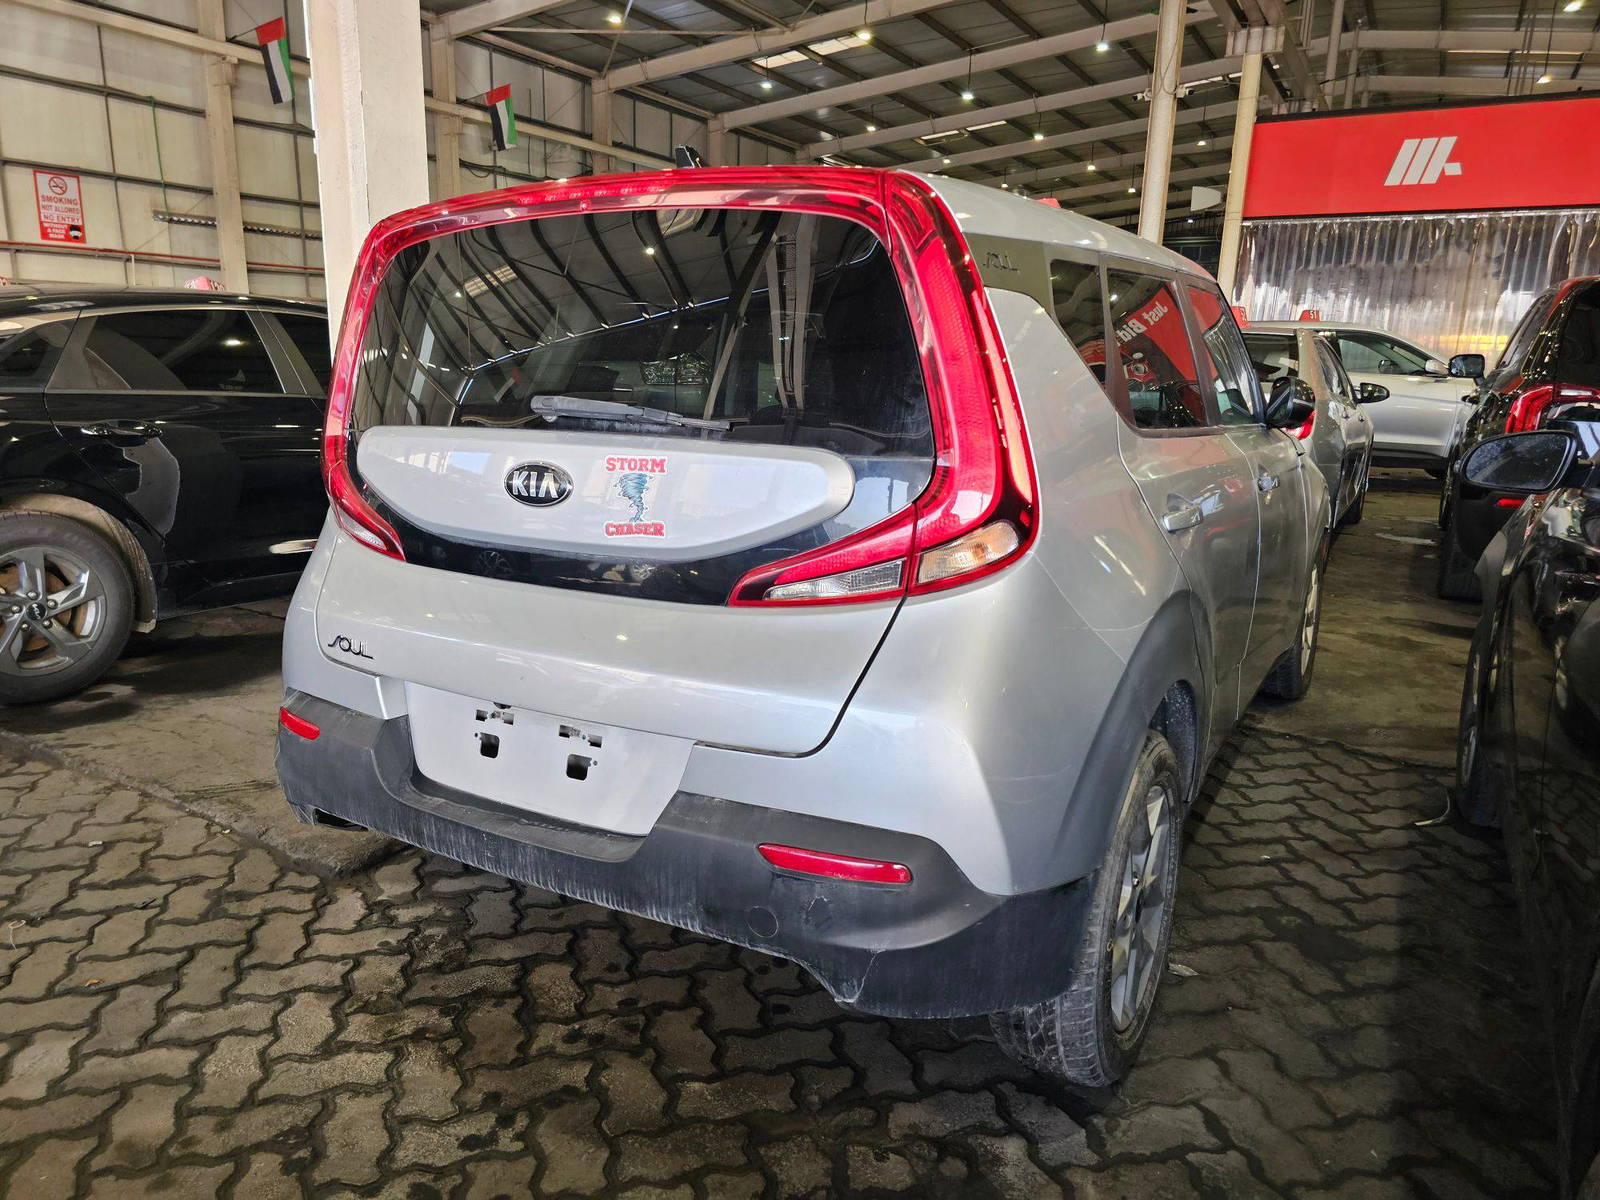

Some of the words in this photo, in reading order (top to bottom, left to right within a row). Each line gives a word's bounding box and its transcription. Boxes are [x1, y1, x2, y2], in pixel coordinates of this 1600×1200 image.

[41, 194, 78, 206] SMOKING
[41, 204, 53, 212] NOT
[54, 205, 80, 215] ALLOWED
[43, 214, 55, 222] NO
[56, 215, 80, 224] ENTRY
[1309, 310, 1317, 320] 51
[605, 457, 667, 473] STORM
[512, 470, 559, 499] KIA
[605, 522, 665, 537] CHASER
[327, 635, 375, 660] SOUL
